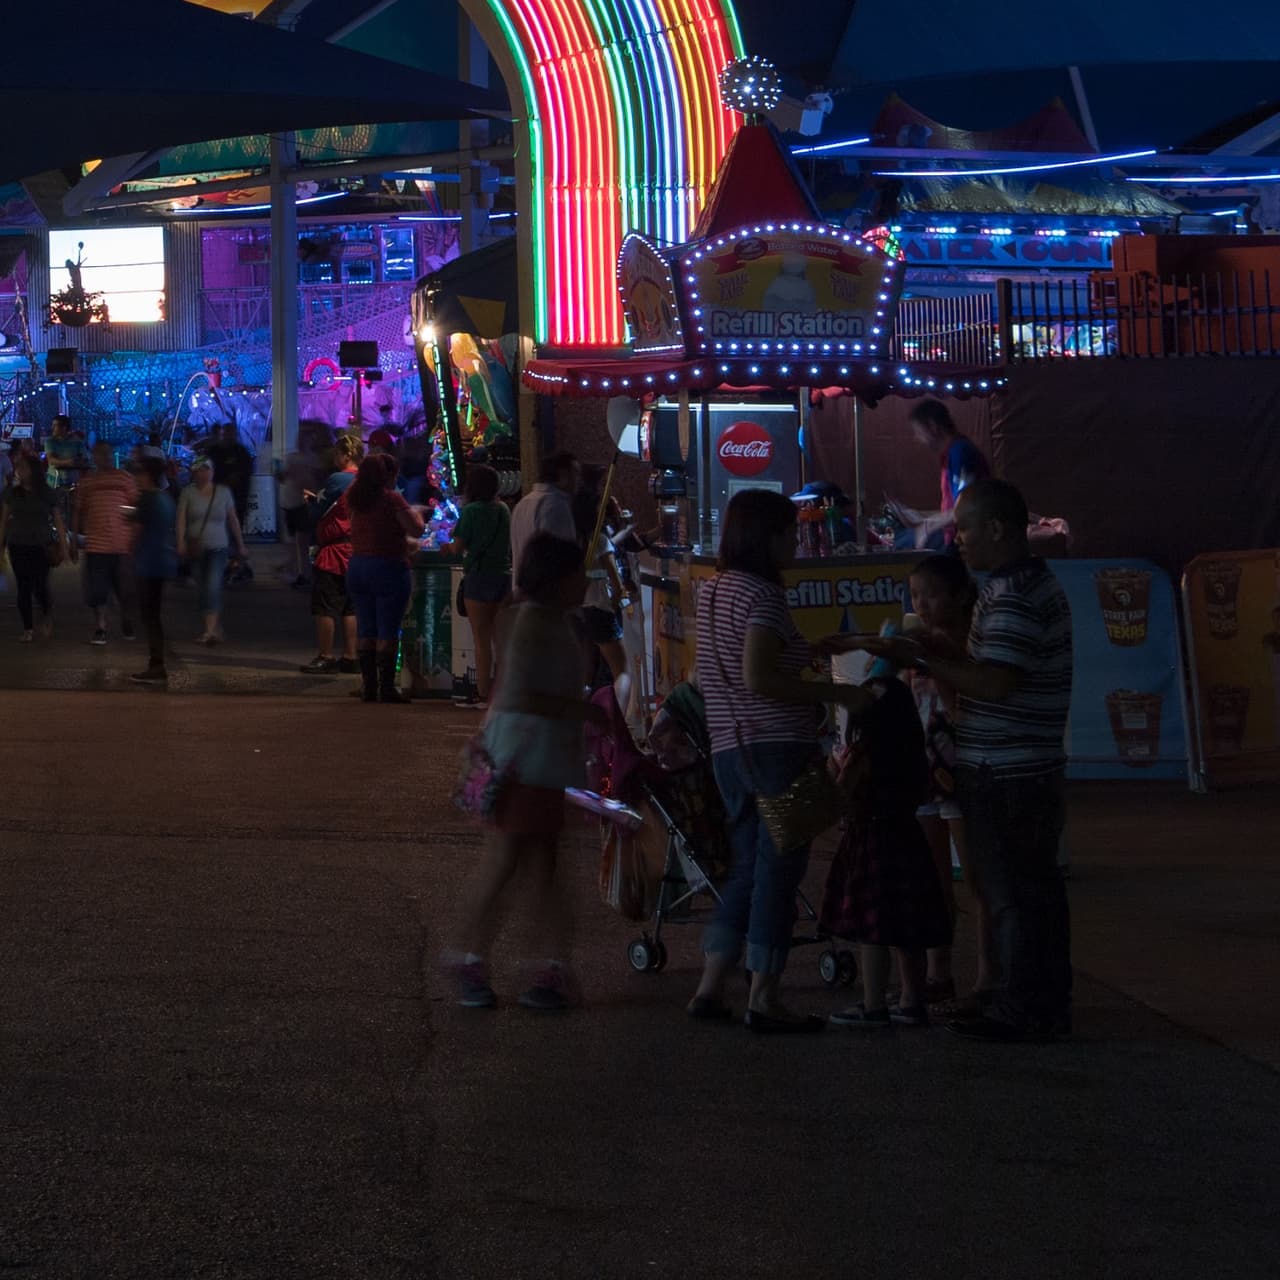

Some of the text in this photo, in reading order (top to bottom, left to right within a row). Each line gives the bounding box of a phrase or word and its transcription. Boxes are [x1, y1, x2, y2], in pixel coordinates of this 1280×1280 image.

[711, 309, 864, 339] Refill Station
[1107, 623, 1146, 640] TEXAS
